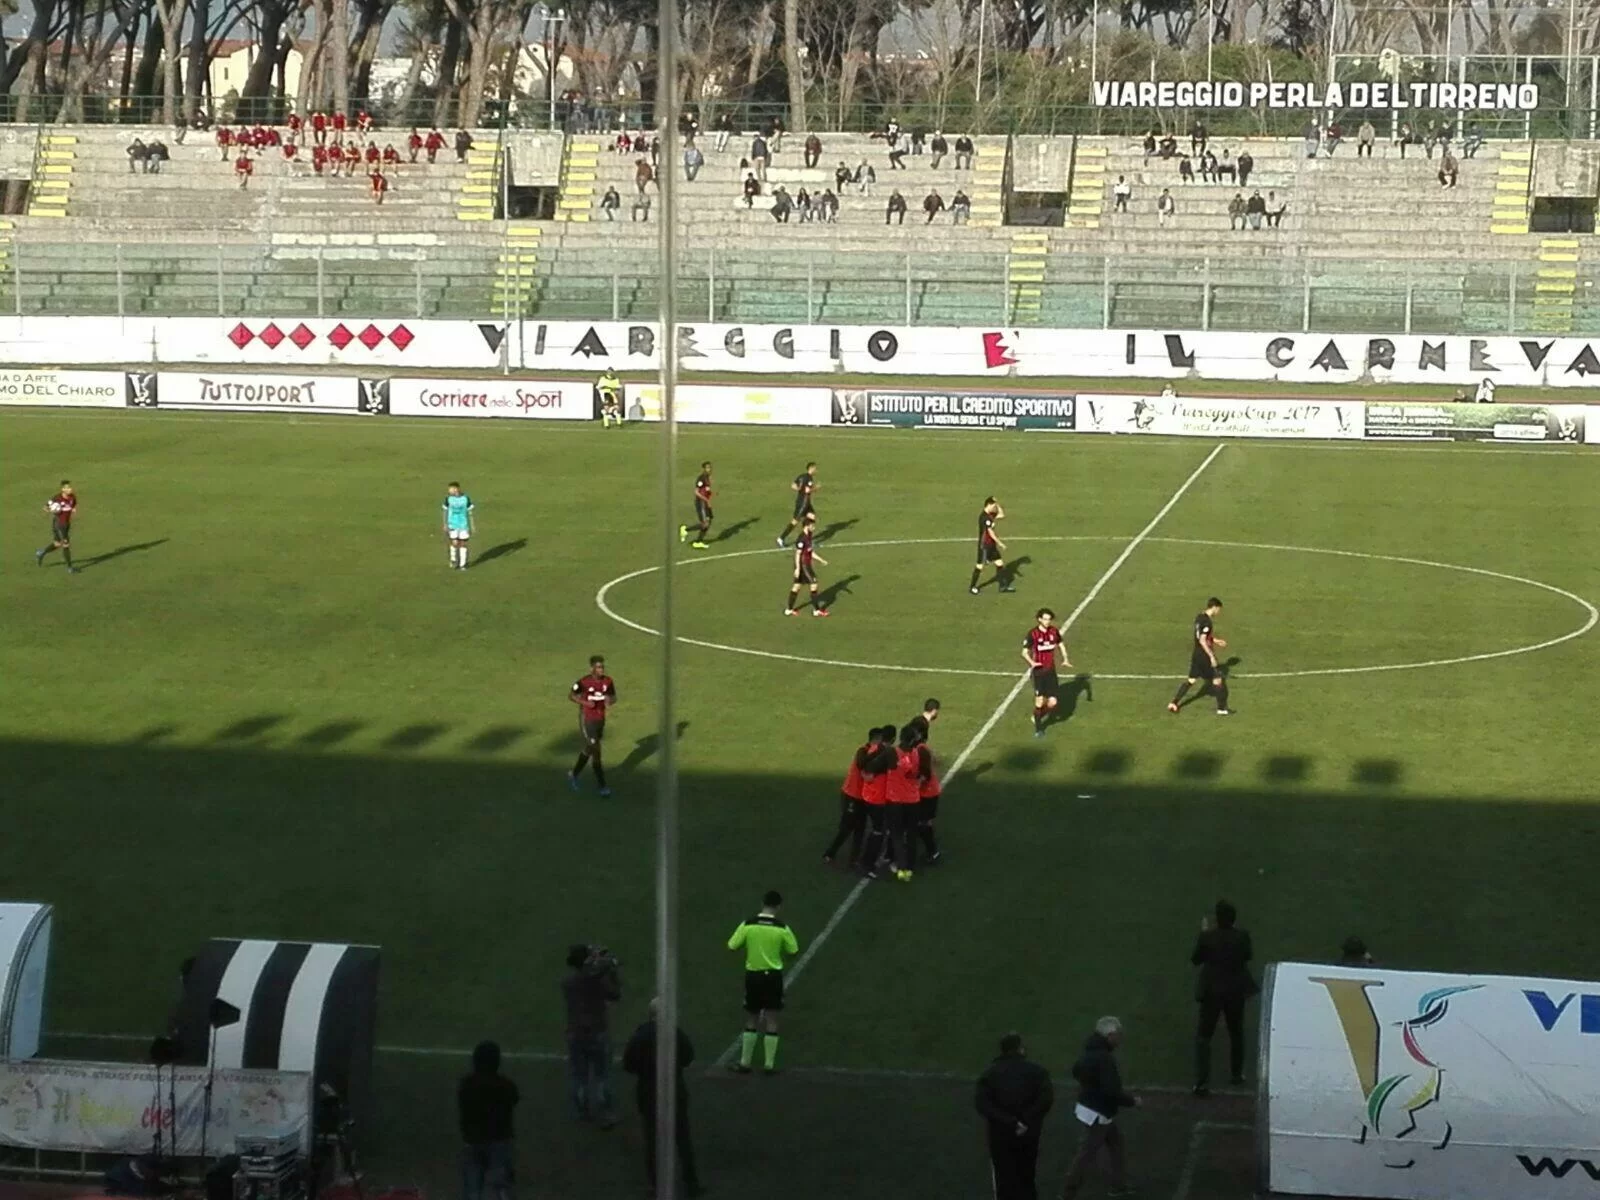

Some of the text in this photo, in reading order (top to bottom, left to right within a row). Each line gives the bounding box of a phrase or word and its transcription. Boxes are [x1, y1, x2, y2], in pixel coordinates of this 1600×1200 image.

[1093, 80, 1538, 110] VIAREGGIO PERLA DEL TIRRENO
[477, 322, 898, 363] VIAREGGIO
[1126, 333, 1196, 368] IL
[22, 383, 54, 396] DEL
[57, 384, 116, 397] CHIARO
[199, 377, 317, 403] TUTTOSPORT
[419, 388, 488, 408] Corriere
[515, 388, 563, 414] Sport
[871, 395, 1074, 417] ISTITUTO PER IL CREDITO SPORTIVO
